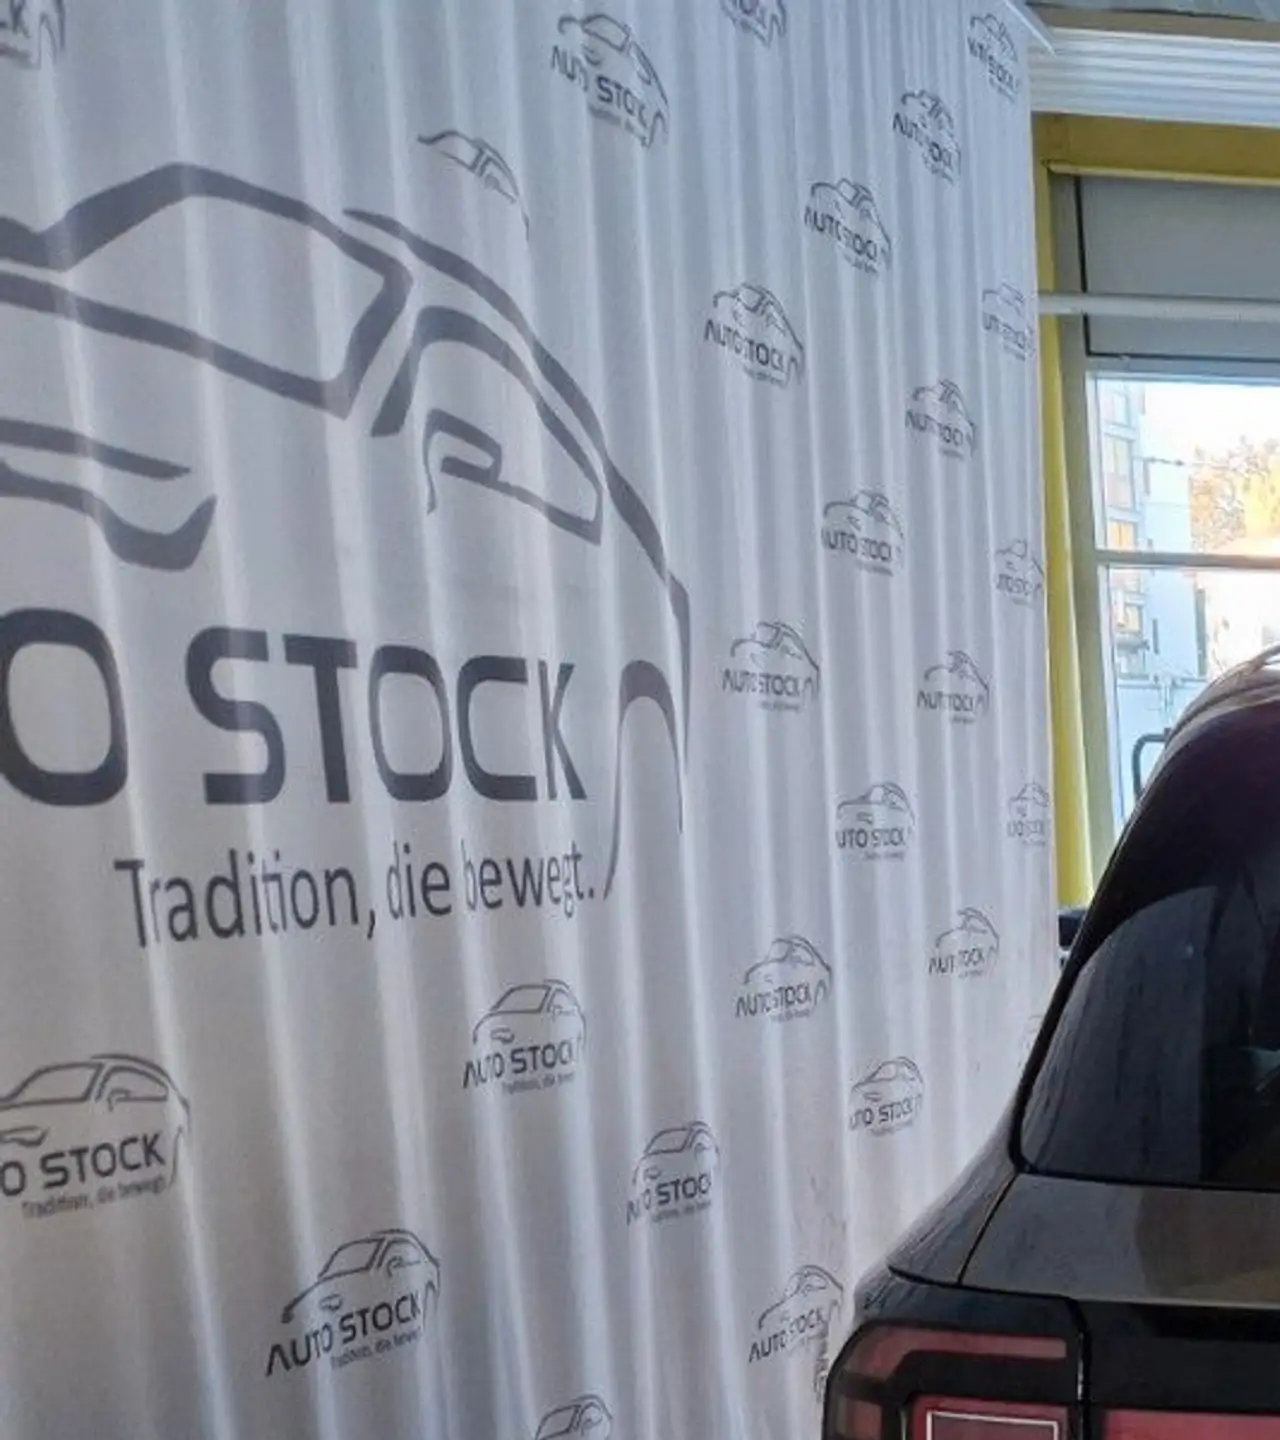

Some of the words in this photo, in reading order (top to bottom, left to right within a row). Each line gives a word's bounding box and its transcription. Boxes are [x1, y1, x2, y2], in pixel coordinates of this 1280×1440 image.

[185, 626, 588, 806] STOCK
[113, 847, 376, 950] Tradition,
[384, 842, 453, 920] die
[459, 838, 596, 920] bewegt.
[510, 1040, 573, 1075] STOC
[39, 1132, 166, 1191] STOCK
[655, 1172, 712, 1207] STOC
[265, 1321, 334, 1378] AUTO
[338, 1290, 422, 1345] STOCK
